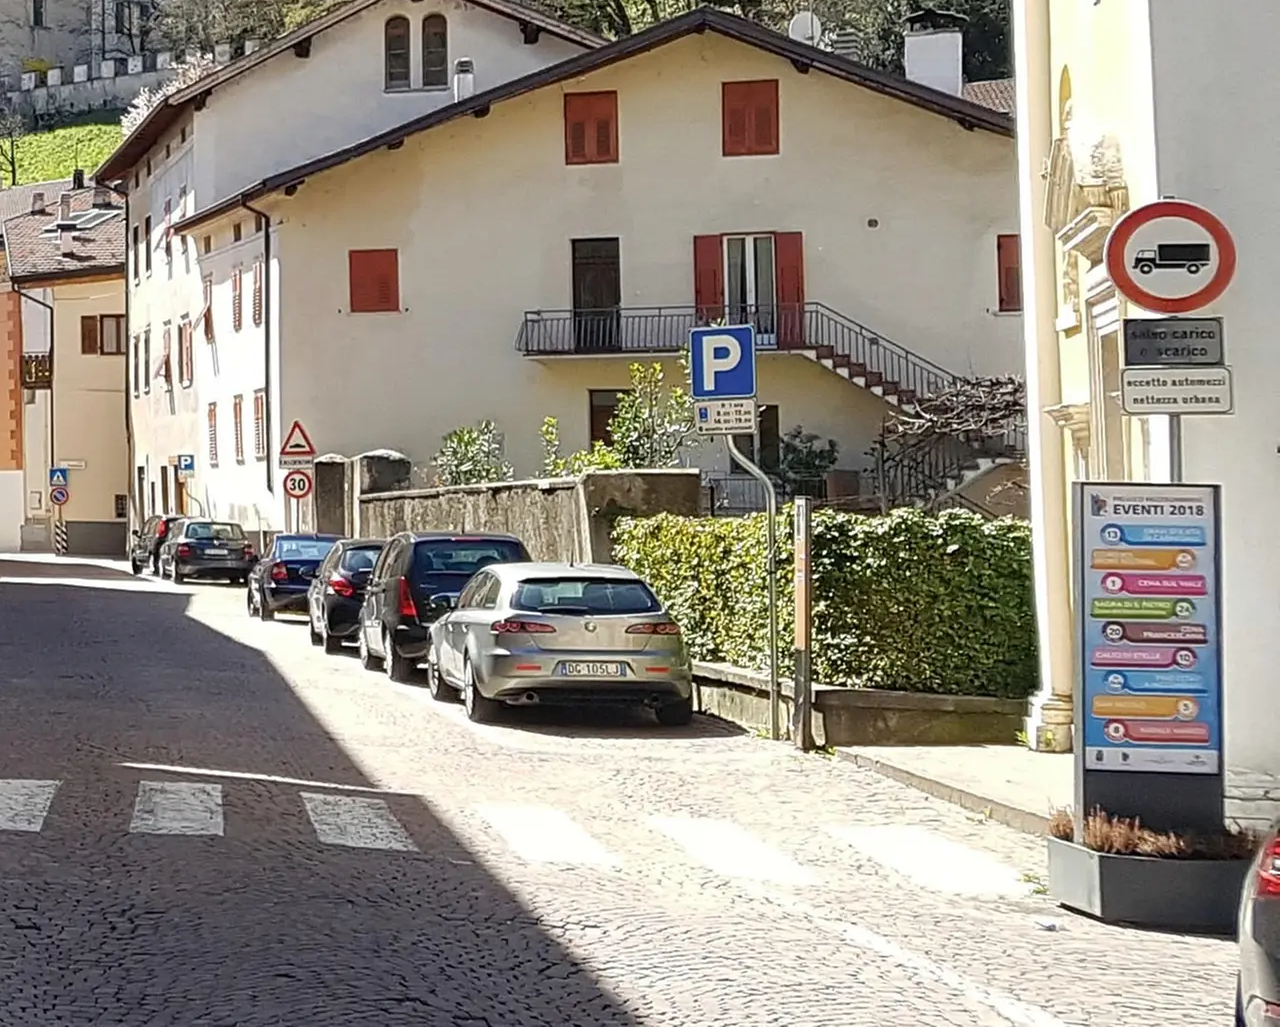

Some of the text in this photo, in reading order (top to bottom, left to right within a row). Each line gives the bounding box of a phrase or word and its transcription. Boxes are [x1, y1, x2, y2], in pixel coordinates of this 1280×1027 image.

[1172, 327, 1215, 340] carico
[1157, 345, 1208, 357] scarico
[702, 335, 741, 391] P
[1127, 376, 1226, 387] eccetto automezzi
[1133, 395, 1220, 405] nettezza urbana
[181, 456, 192, 469] P
[289, 478, 306, 491] 30
[1113, 504, 1205, 516] EVENTI 2018
[1107, 531, 1118, 539] 13
[1109, 628, 1121, 636] 20
[1179, 654, 1191, 662] 10
